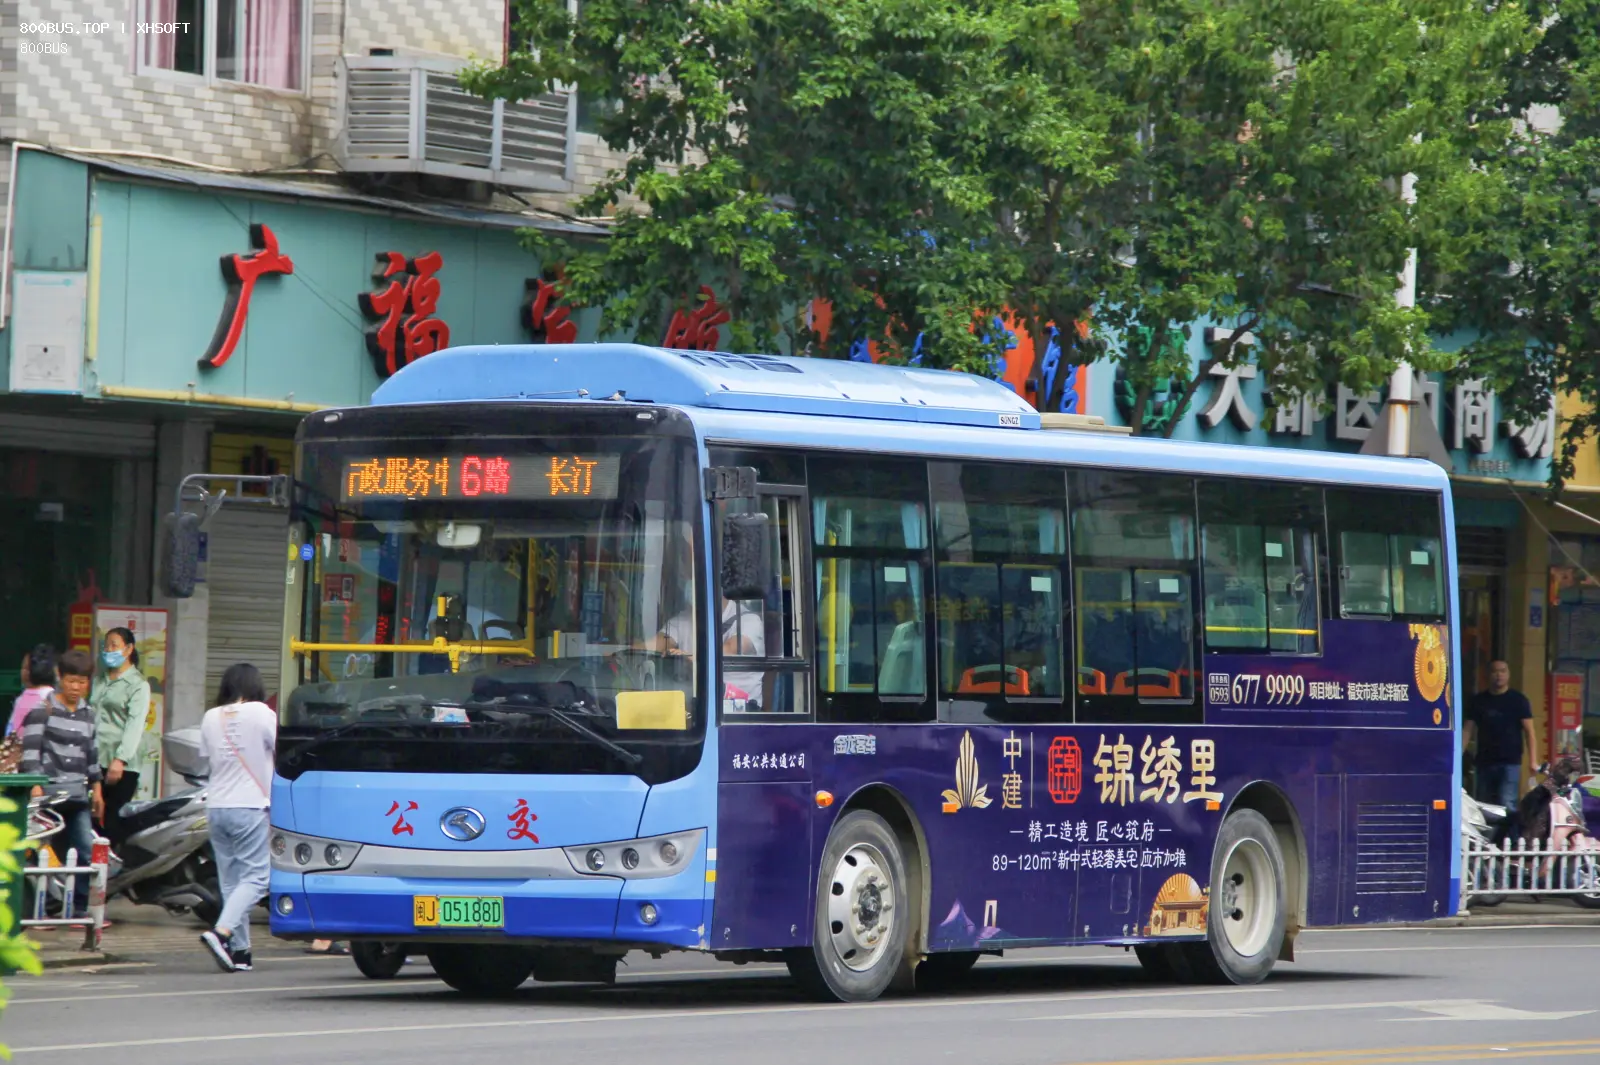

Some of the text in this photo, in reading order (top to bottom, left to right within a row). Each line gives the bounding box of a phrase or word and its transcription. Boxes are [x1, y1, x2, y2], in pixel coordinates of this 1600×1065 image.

[460, 456, 511, 496] 6路
[544, 456, 597, 496] 长汀
[1210, 687, 1229, 702] 0593
[1232, 674, 1305, 704] 677 9999
[732, 752, 806, 770] 福安公共交通公司
[1002, 730, 1023, 809] 中建
[1093, 733, 1224, 806] 锦绣里
[1028, 818, 1155, 843] 精工造境 匠心筑府
[1141, 848, 1187, 869] 应市加推
